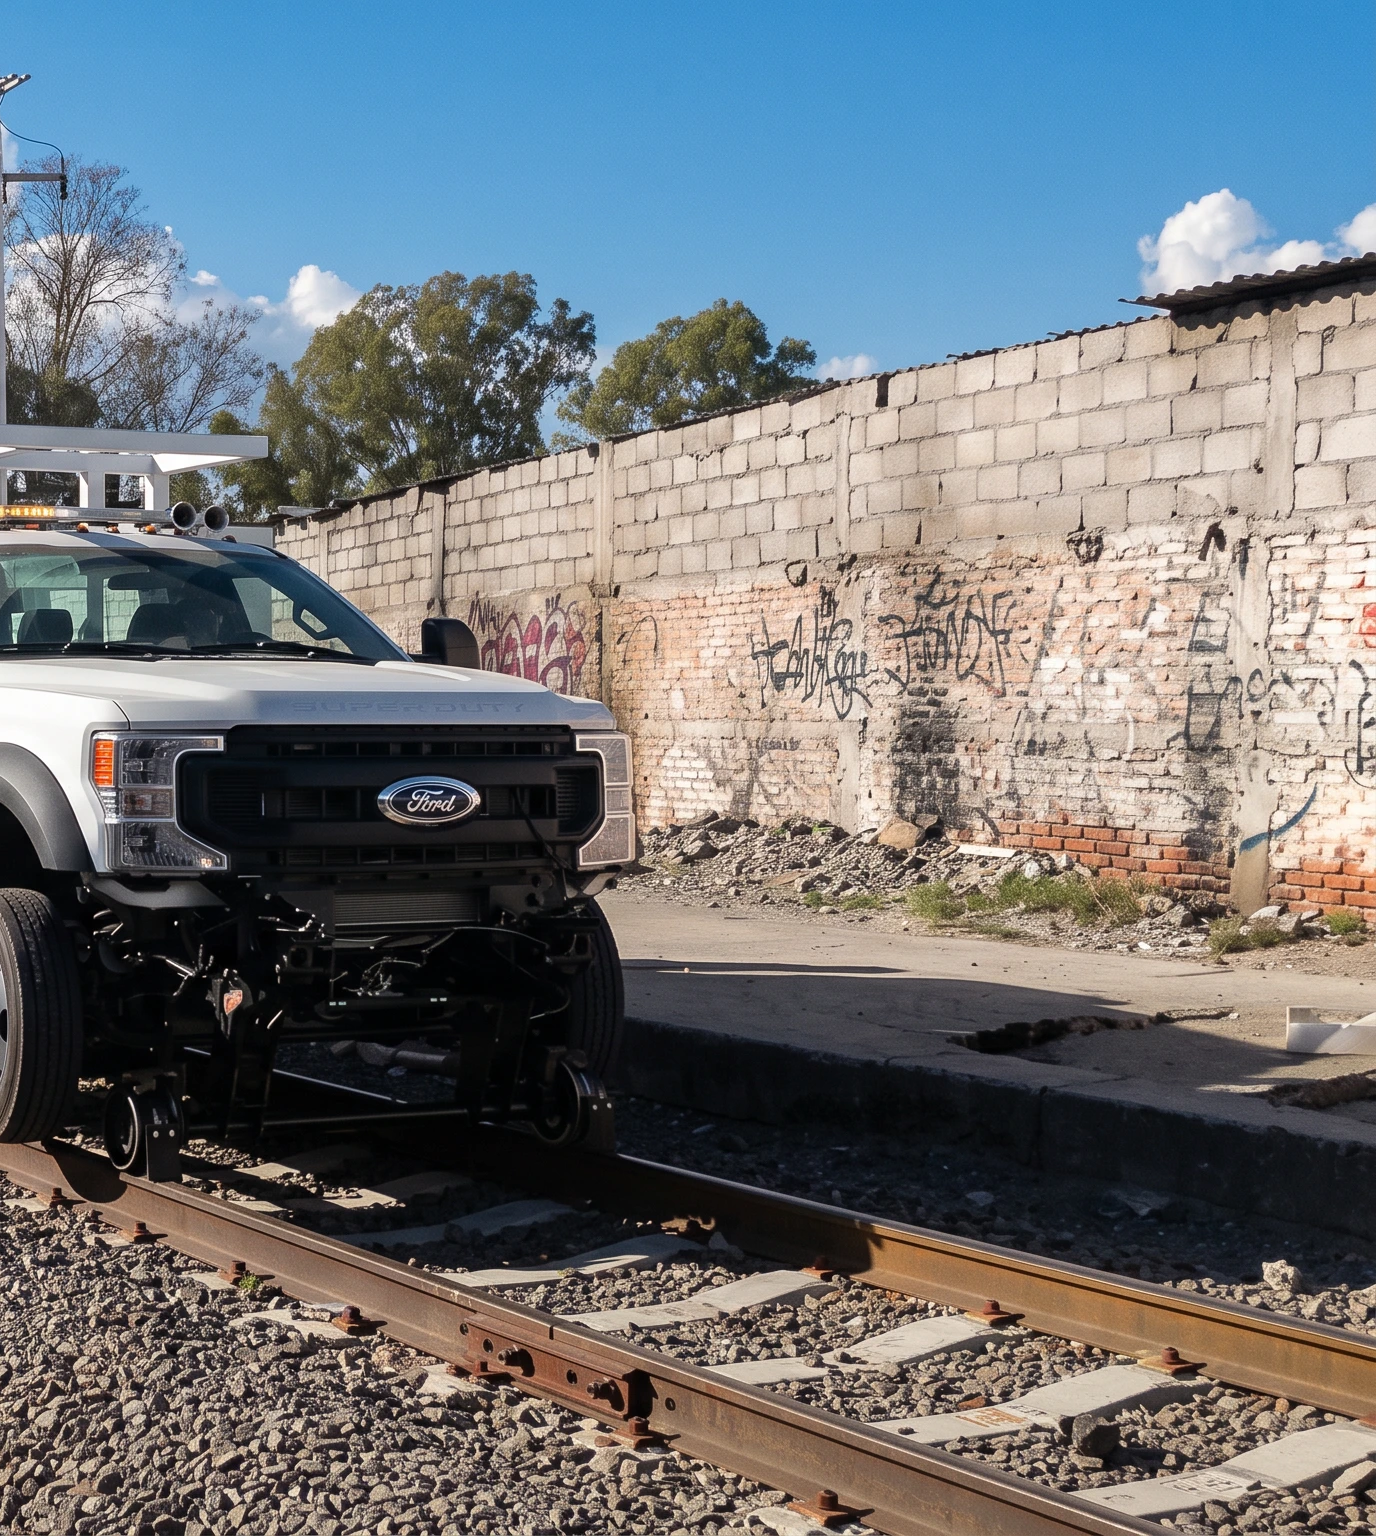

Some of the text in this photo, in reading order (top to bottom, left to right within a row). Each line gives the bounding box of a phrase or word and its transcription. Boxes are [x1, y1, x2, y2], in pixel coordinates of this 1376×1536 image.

[292, 702, 524, 713] SUPER DUTY
[407, 789, 457, 812] Ford
